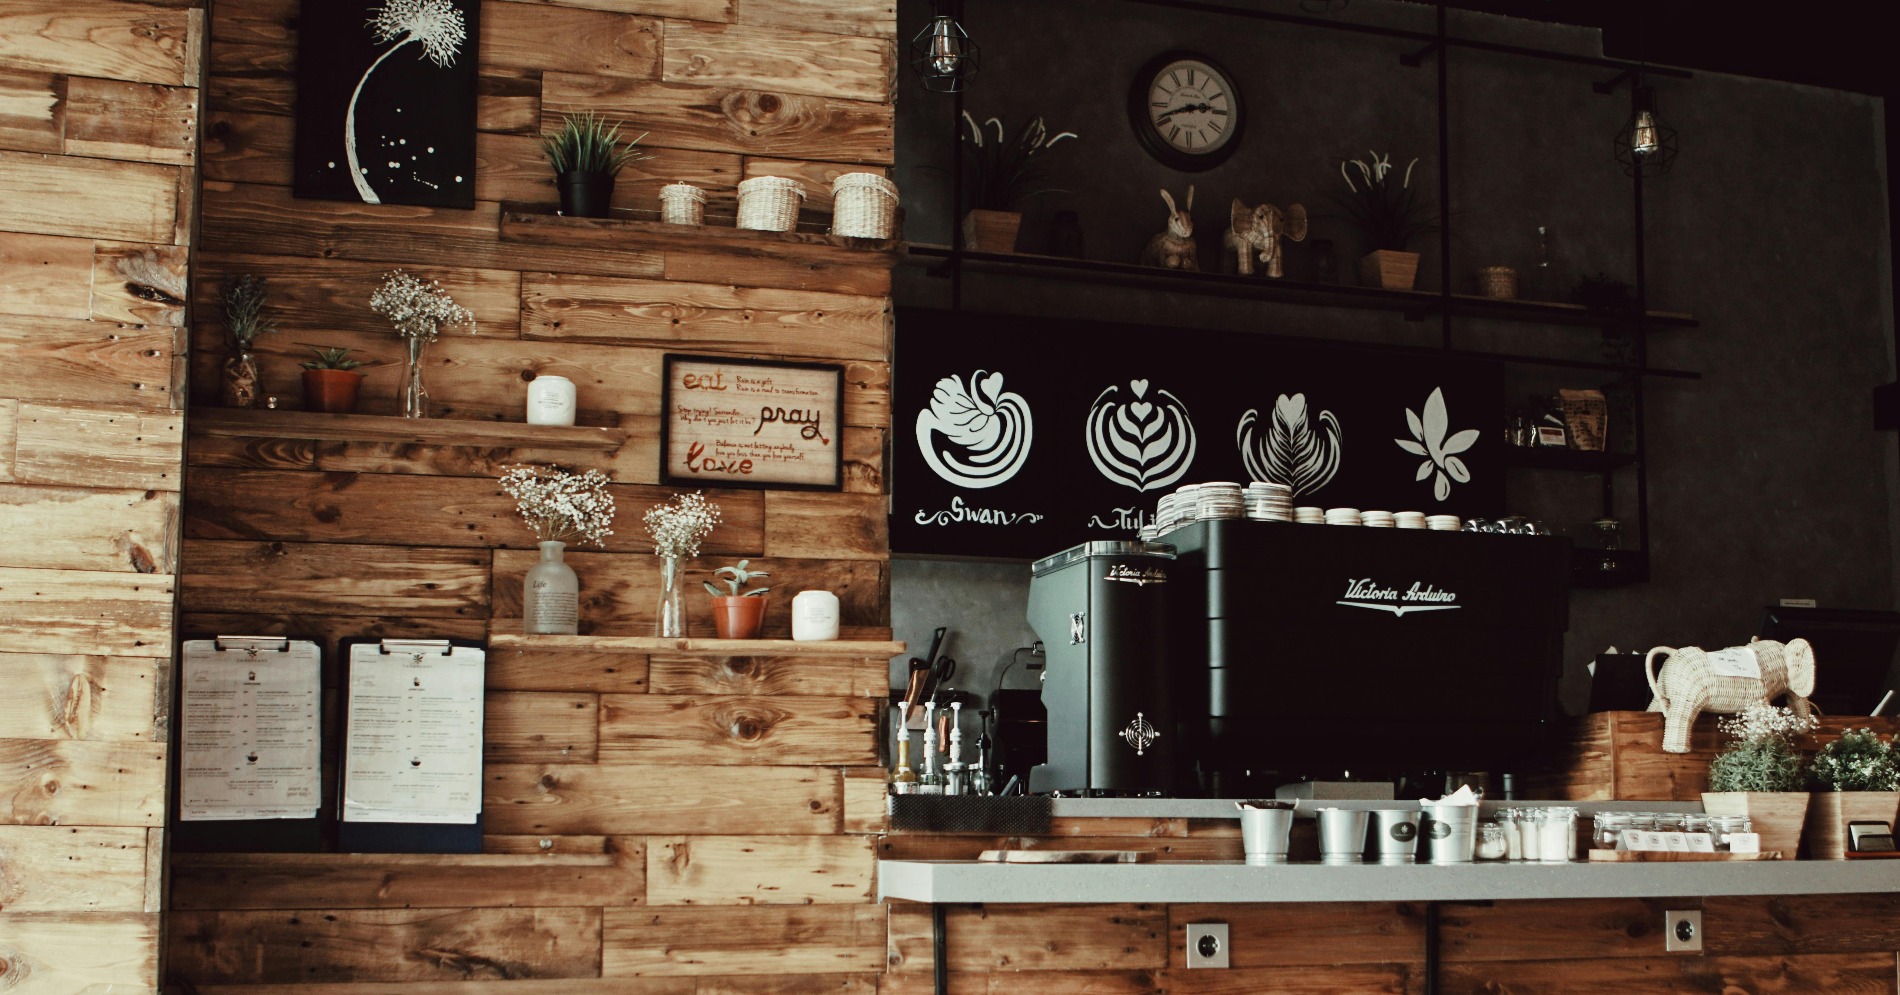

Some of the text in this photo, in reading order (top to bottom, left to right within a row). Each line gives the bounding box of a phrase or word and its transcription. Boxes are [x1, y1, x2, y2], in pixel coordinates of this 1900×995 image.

[683, 368, 727, 390] eat
[678, 405, 692, 416] Stop
[680, 414, 692, 425] Why
[708, 418, 717, 426] you
[717, 418, 729, 426] just
[754, 406, 822, 440] pray
[715, 439, 737, 448] Balance
[754, 441, 772, 452] letting
[773, 443, 795, 453] anybody
[727, 451, 736, 459] you
[940, 496, 1015, 526] Swan
[1112, 506, 1156, 538] Tuli
[1110, 564, 1141, 577] Victoria
[532, 580, 547, 589] Life
[1344, 578, 1456, 602] Victoria Arduino
